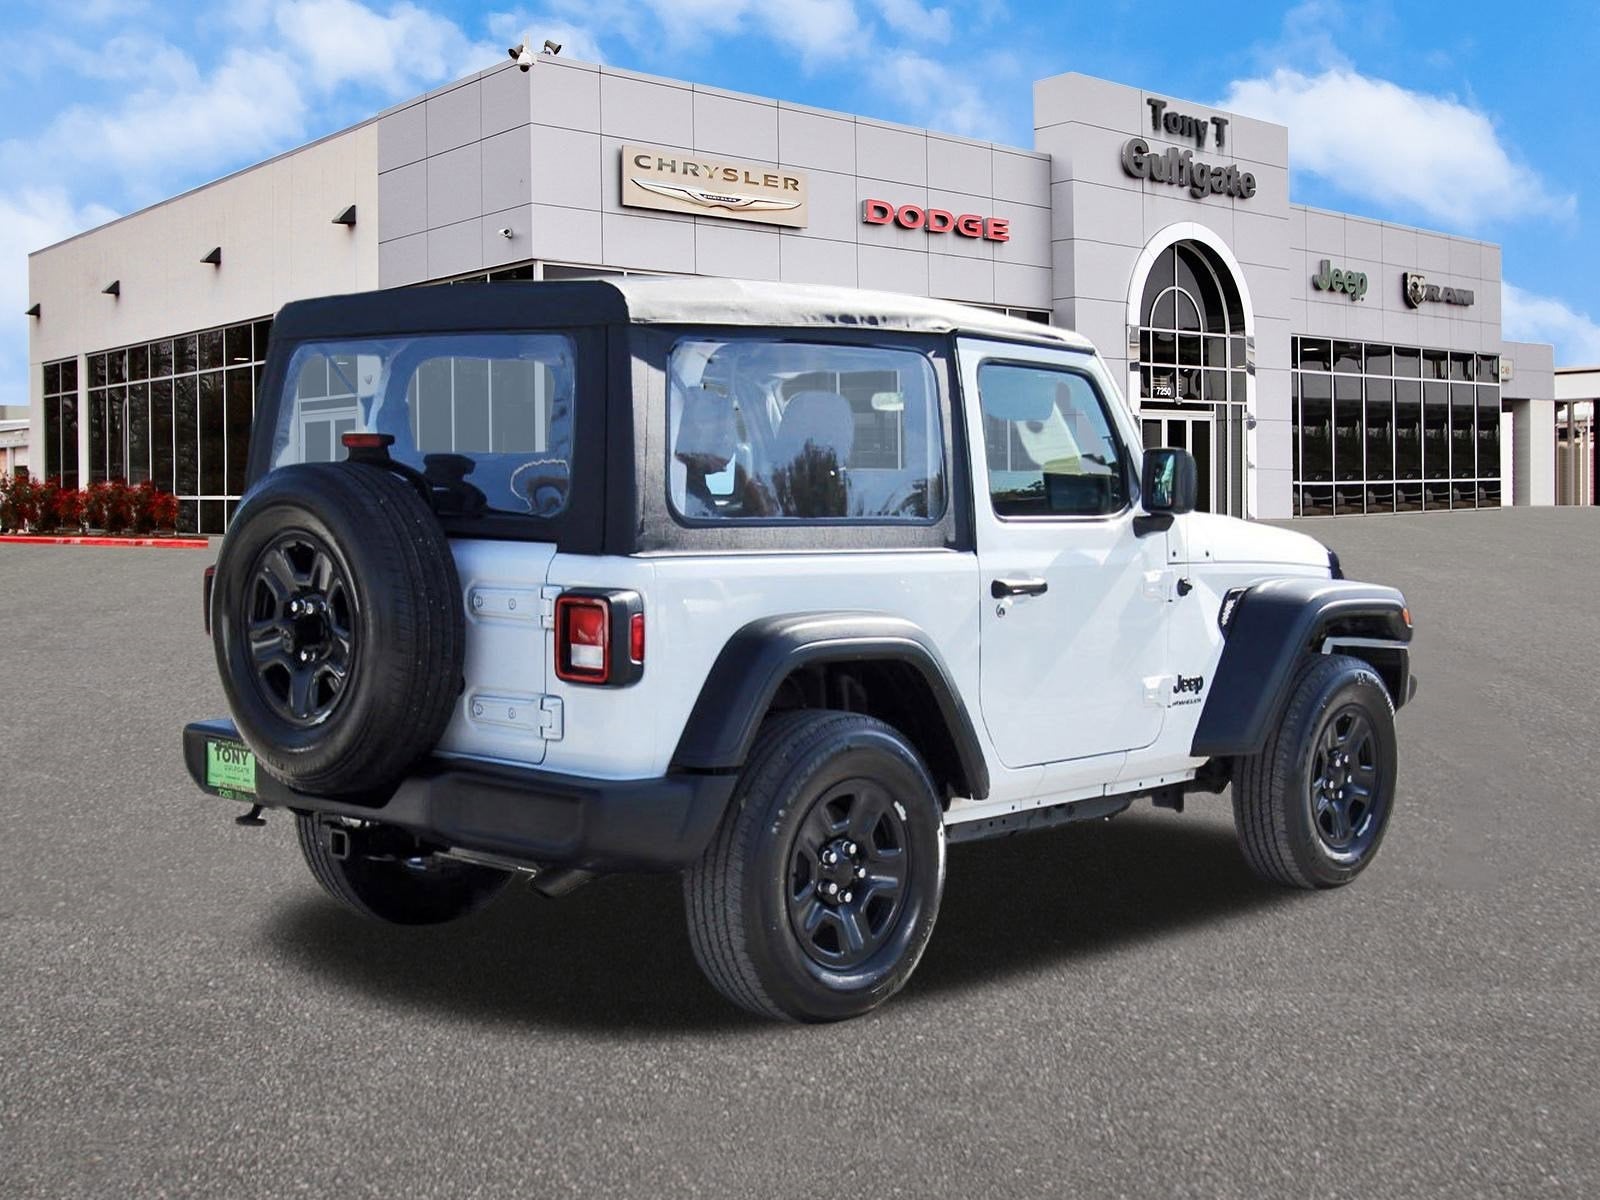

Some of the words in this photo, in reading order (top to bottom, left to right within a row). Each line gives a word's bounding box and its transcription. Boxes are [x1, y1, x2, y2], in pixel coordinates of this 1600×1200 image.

[1147, 98, 1208, 148] Tony
[1211, 116, 1229, 147] T
[633, 154, 800, 191] CHRYSLER
[1121, 138, 1257, 198] Gulfgate
[862, 198, 1010, 242] DODGE
[1312, 259, 1368, 301] Jeep
[1425, 284, 1475, 306] RAM
[1156, 386, 1171, 396] 7250
[1173, 674, 1204, 695] Jeep
[215, 746, 248, 766] TONY
